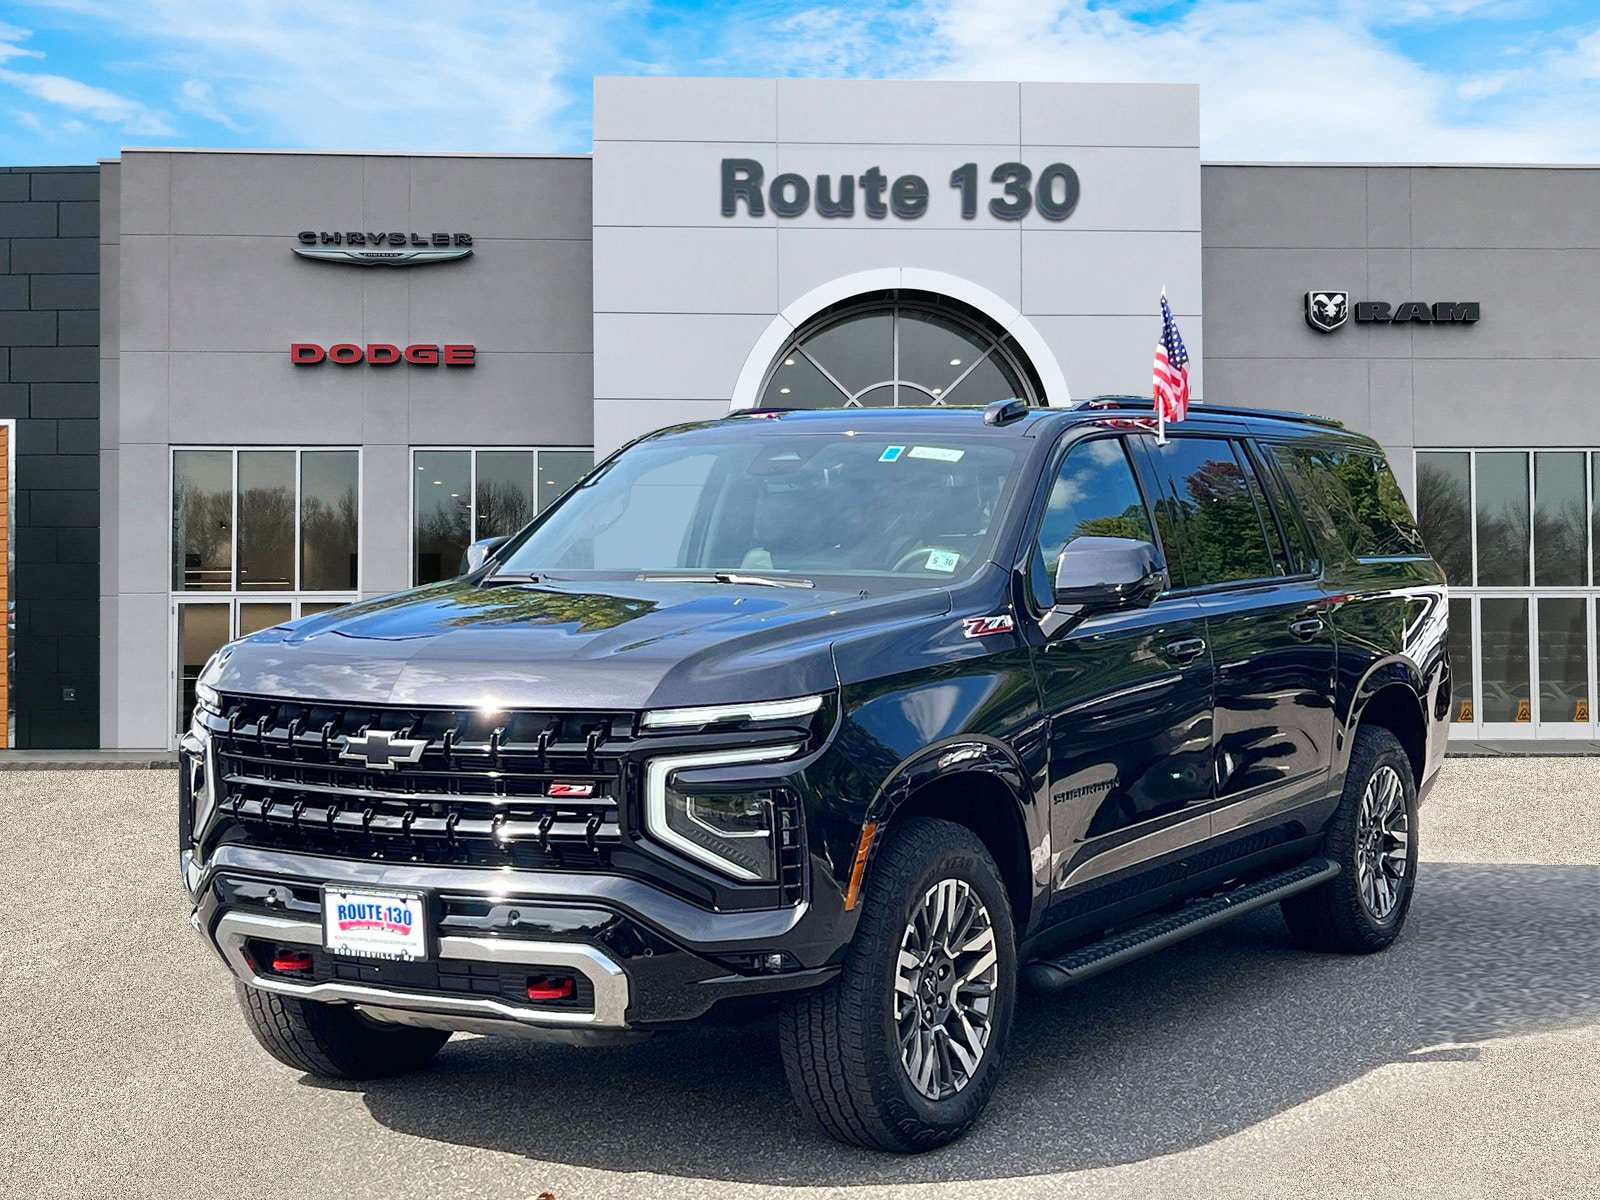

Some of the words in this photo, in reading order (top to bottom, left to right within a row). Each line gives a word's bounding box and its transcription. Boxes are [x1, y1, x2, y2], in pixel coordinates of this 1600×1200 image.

[721, 158, 929, 219] Route
[950, 162, 1081, 221] 130
[298, 231, 473, 245] CHRYSLER
[1355, 302, 1480, 324] RAM
[291, 343, 476, 366] DODGE
[962, 614, 1014, 639] Z71
[547, 783, 594, 797] Z71
[337, 903, 383, 921] ROUTE
[386, 906, 413, 926] 130
